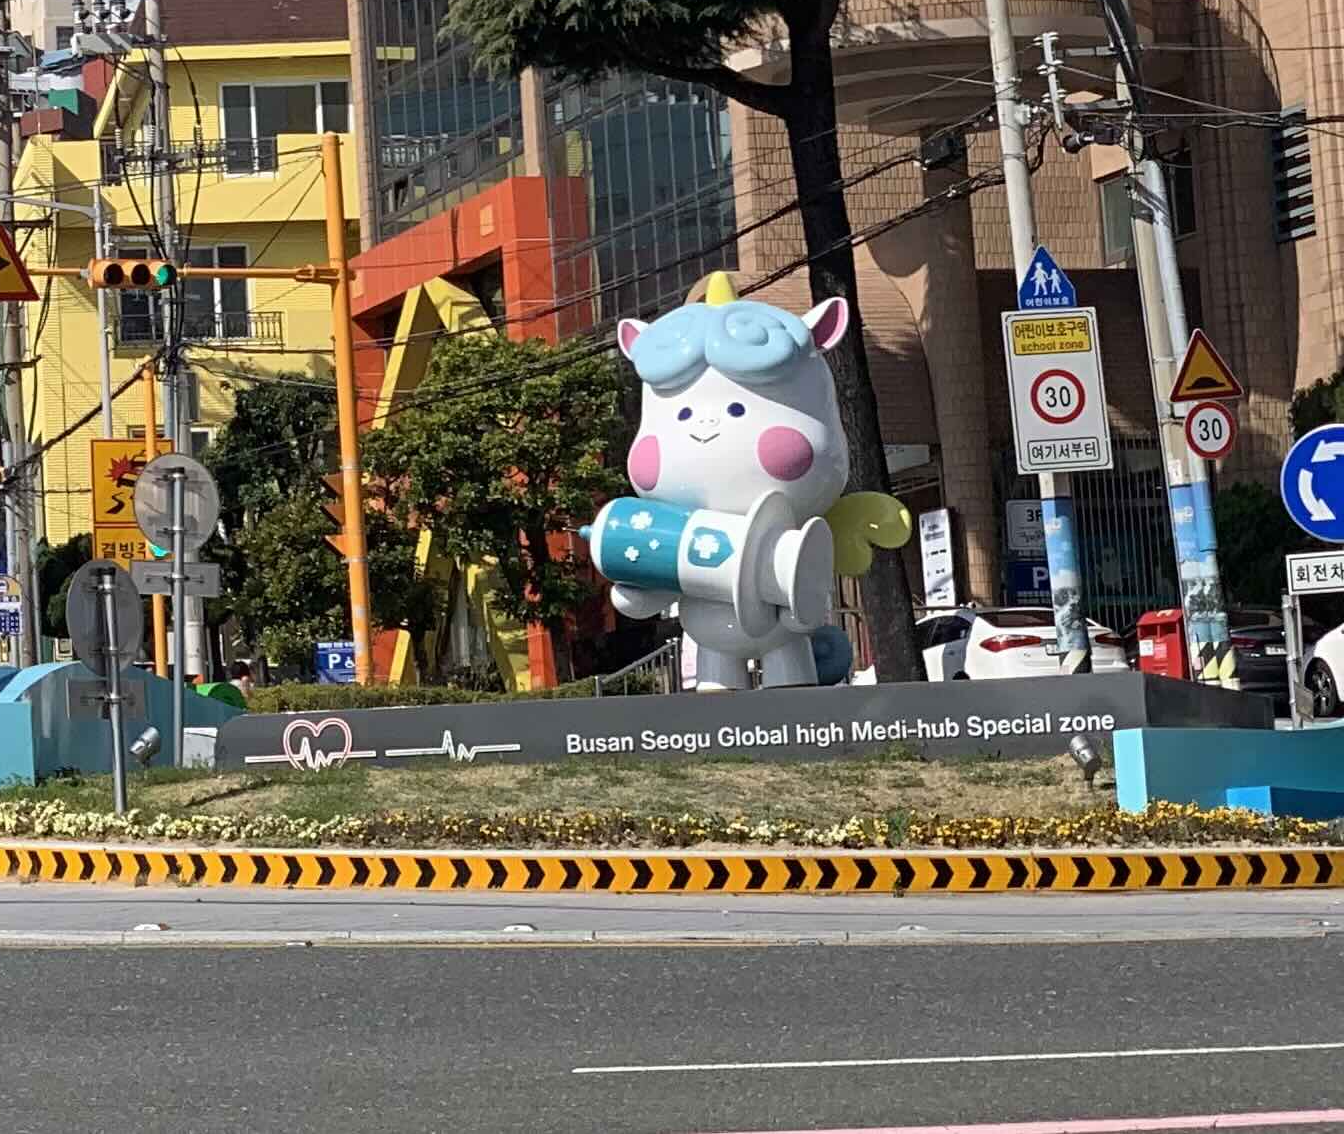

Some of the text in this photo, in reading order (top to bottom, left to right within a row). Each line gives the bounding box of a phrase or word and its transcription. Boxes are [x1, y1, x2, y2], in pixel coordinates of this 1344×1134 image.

[1014, 320, 1088, 339] 어린이보호구역
[1021, 340, 1084, 352] school zone
[1045, 386, 1071, 408] 30
[1198, 418, 1222, 441] 30
[1031, 442, 1097, 461] 여기서부터
[328, 653, 341, 669] P
[566, 713, 1115, 755] Busan Seogu Global high Medi-hub Special zone
